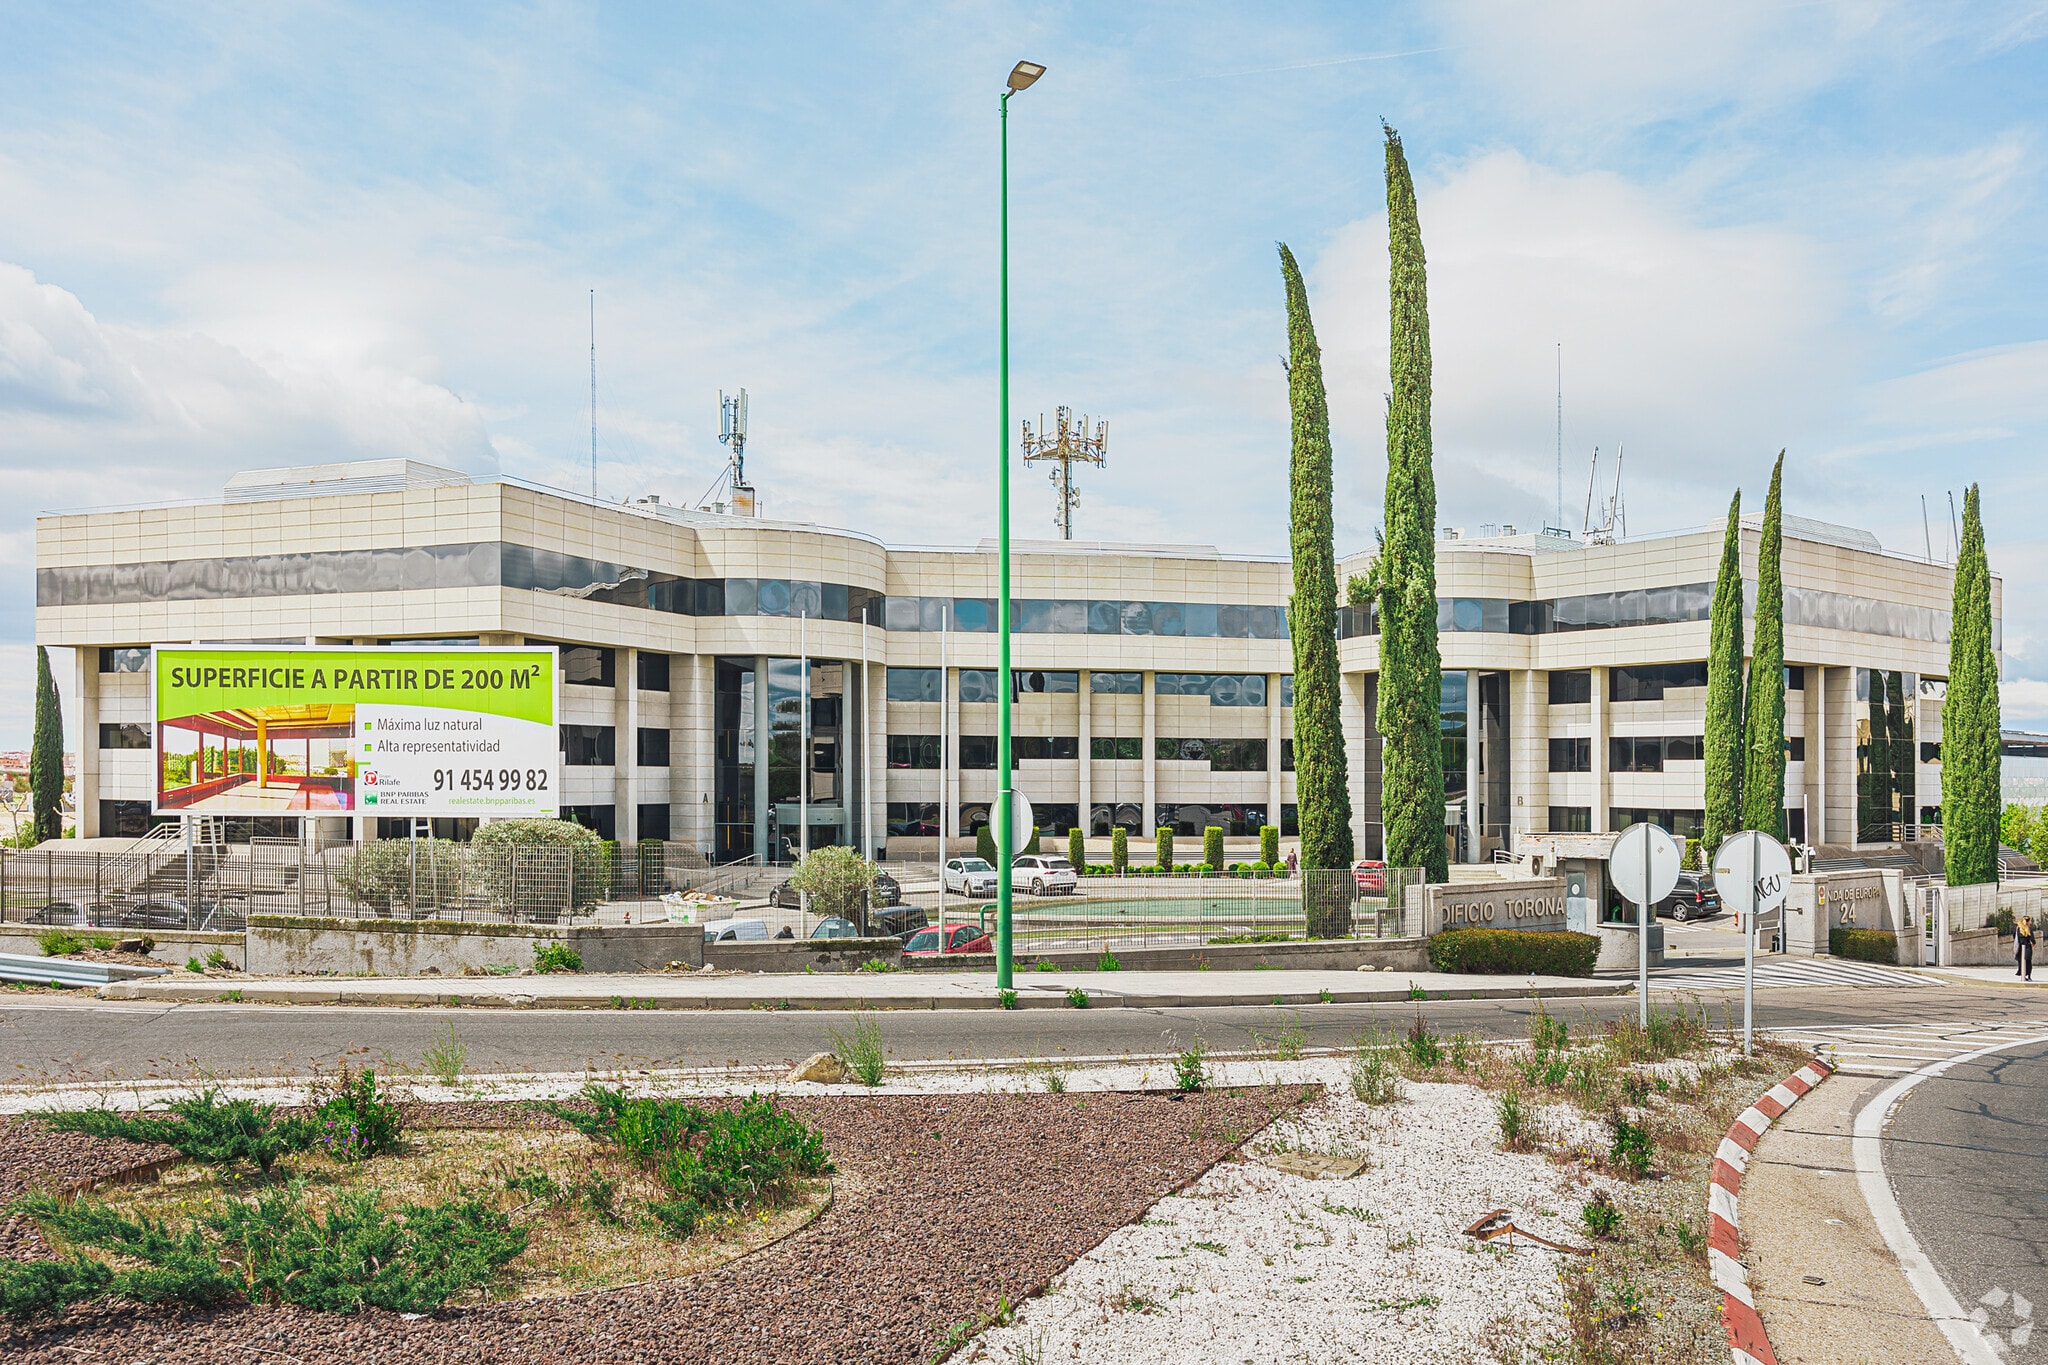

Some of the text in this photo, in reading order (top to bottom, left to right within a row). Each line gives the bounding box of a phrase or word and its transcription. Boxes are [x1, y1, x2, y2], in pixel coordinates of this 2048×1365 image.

[171, 664, 540, 690] SUPERFICIE A PARTIR DE 200 M²
[377, 718, 482, 731] Máxima luz natural
[377, 739, 501, 755] Alta representatividad
[379, 778, 401, 786] Rilafe
[434, 769, 548, 791] 91 454 99 82
[448, 796, 536, 806] realestate.bnpparibas.es
[1442, 896, 1565, 925] DIFICIO TORONA
[1840, 902, 1857, 924] 24
